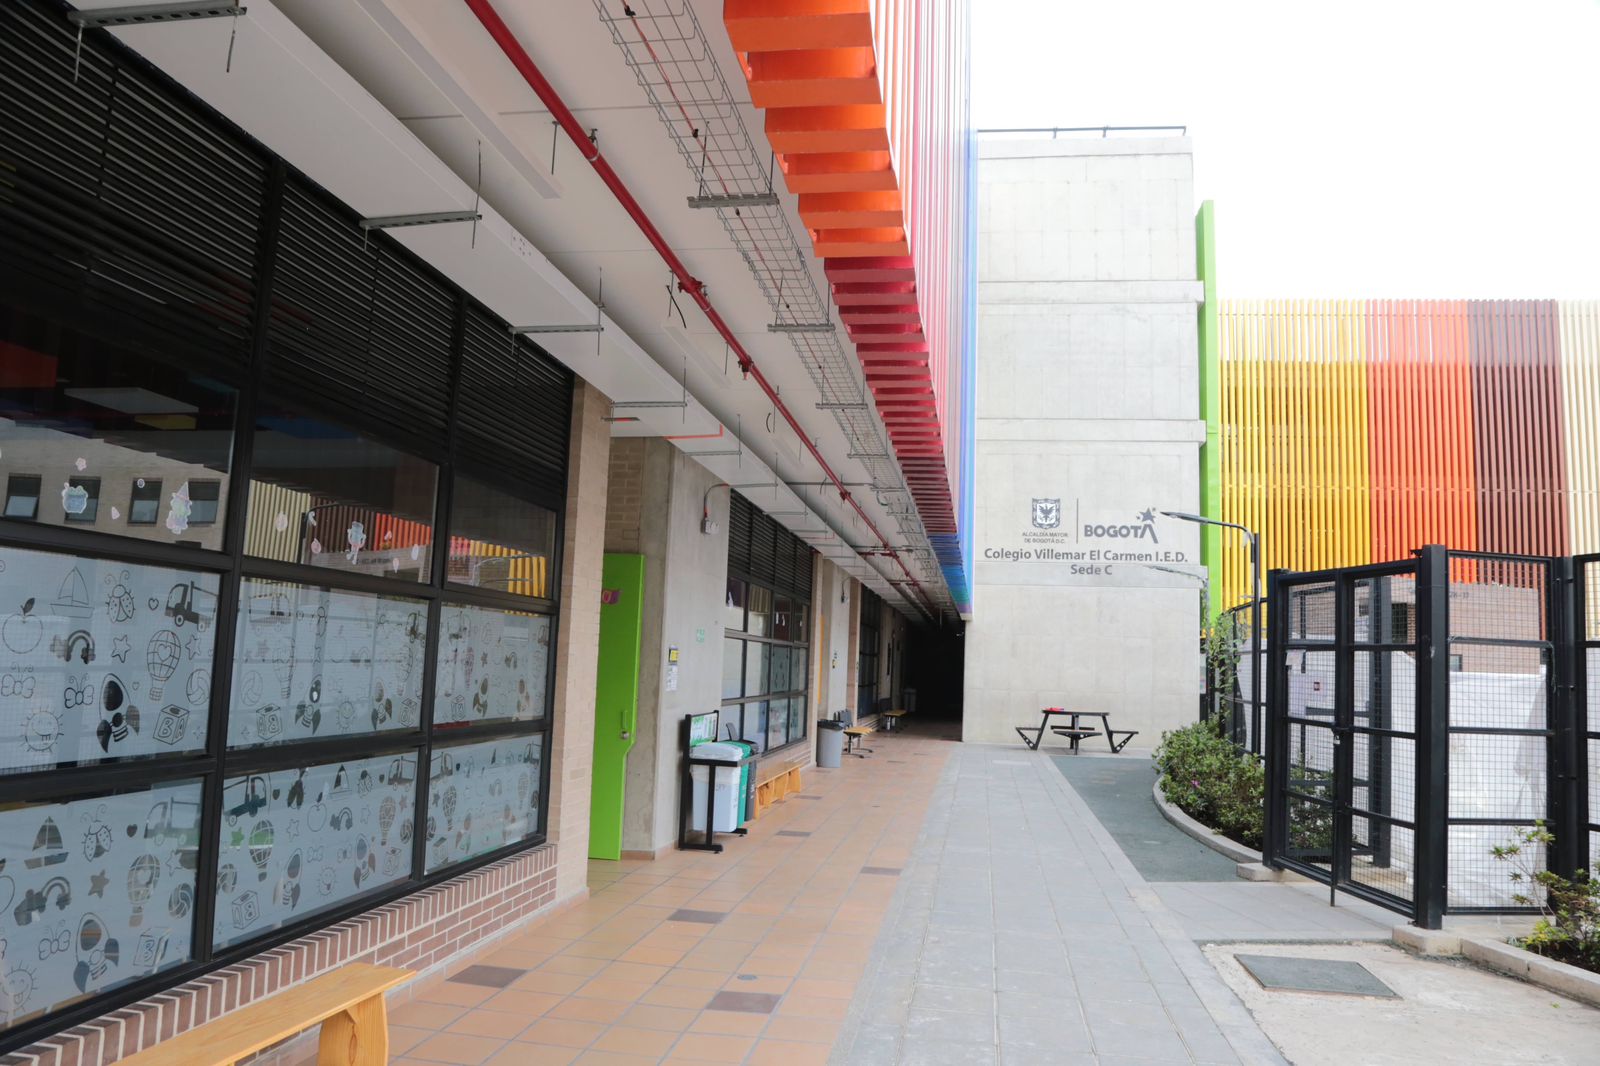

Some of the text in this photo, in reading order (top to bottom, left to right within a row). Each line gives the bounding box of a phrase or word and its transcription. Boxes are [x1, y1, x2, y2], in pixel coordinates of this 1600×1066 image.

[984, 548, 1188, 562] Colegio Villemar El Carmen I.E.D.
[1070, 564, 1112, 575] Sede C
